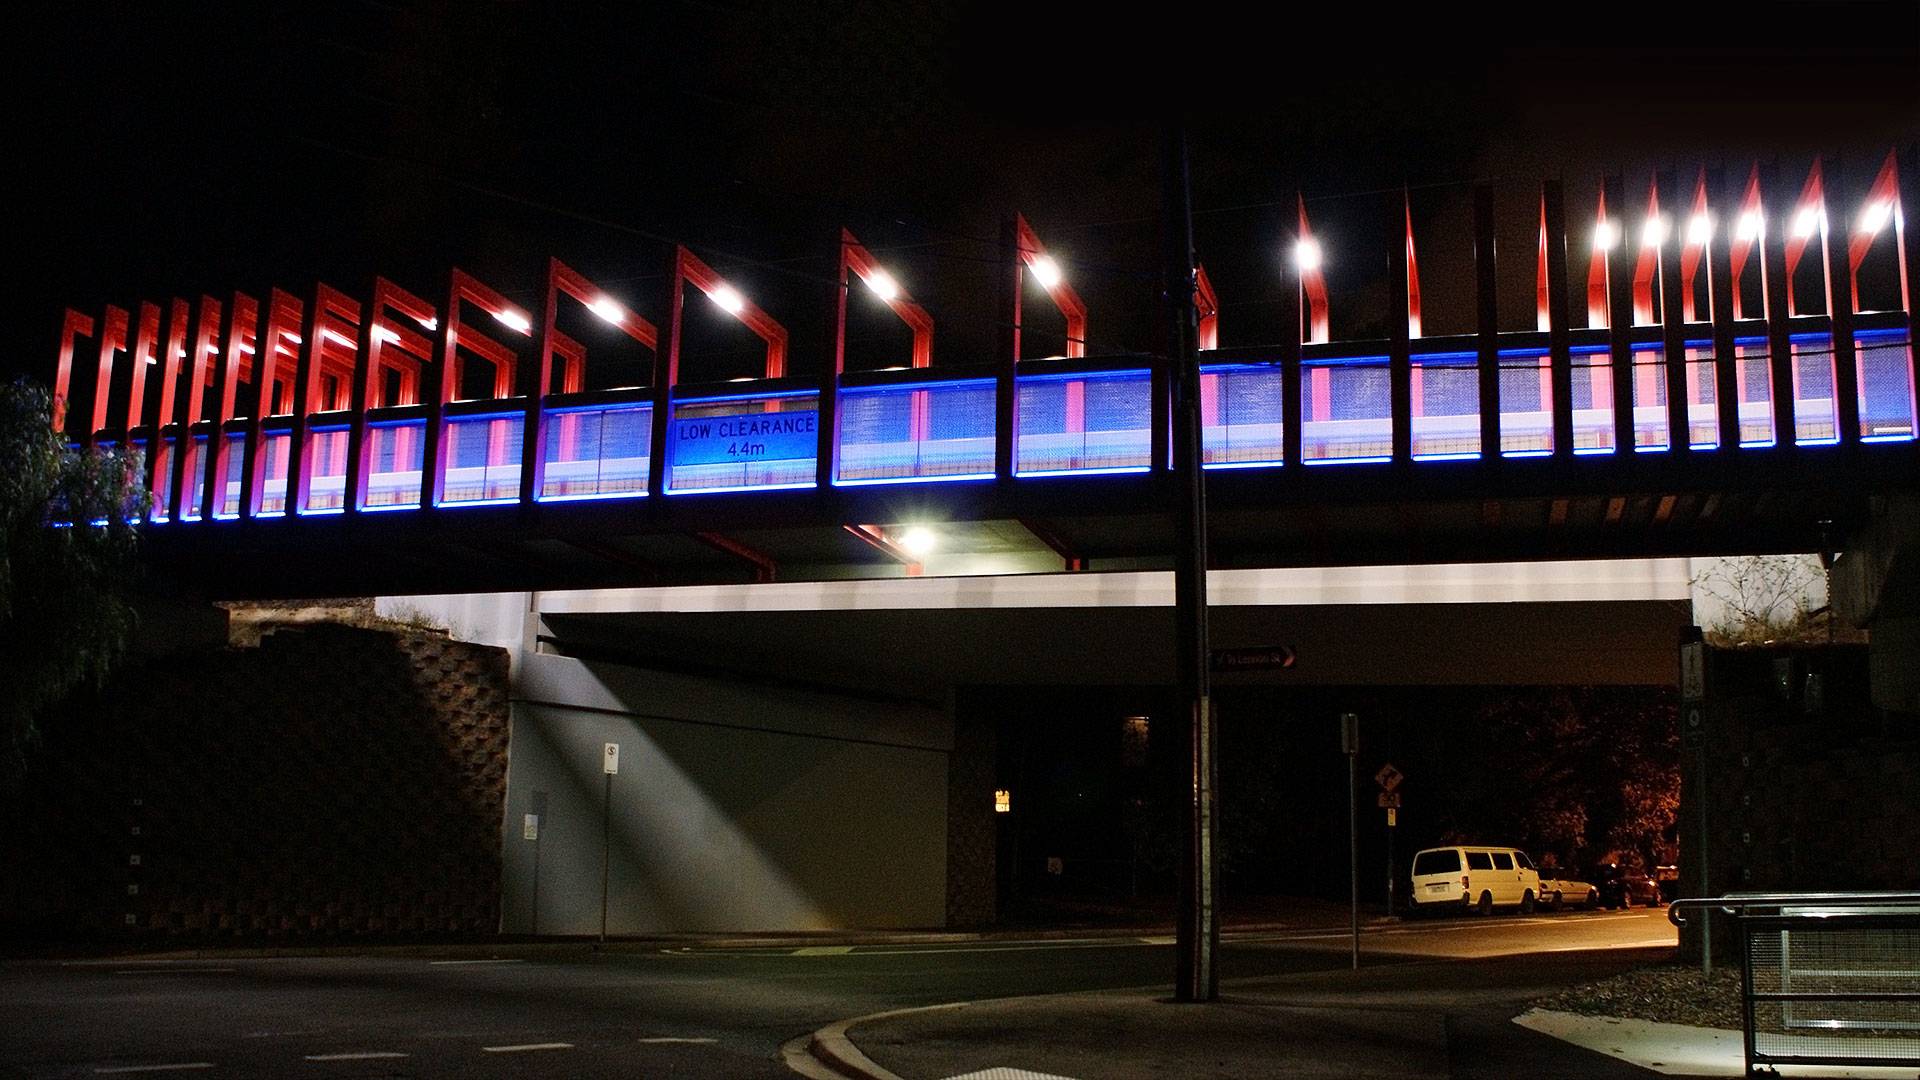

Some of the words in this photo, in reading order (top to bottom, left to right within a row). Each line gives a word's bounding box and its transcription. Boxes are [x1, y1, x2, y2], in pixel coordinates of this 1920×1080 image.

[680, 424, 711, 440] LOW
[718, 417, 815, 438] CLEARANCE
[727, 441, 765, 456] 4.4m
